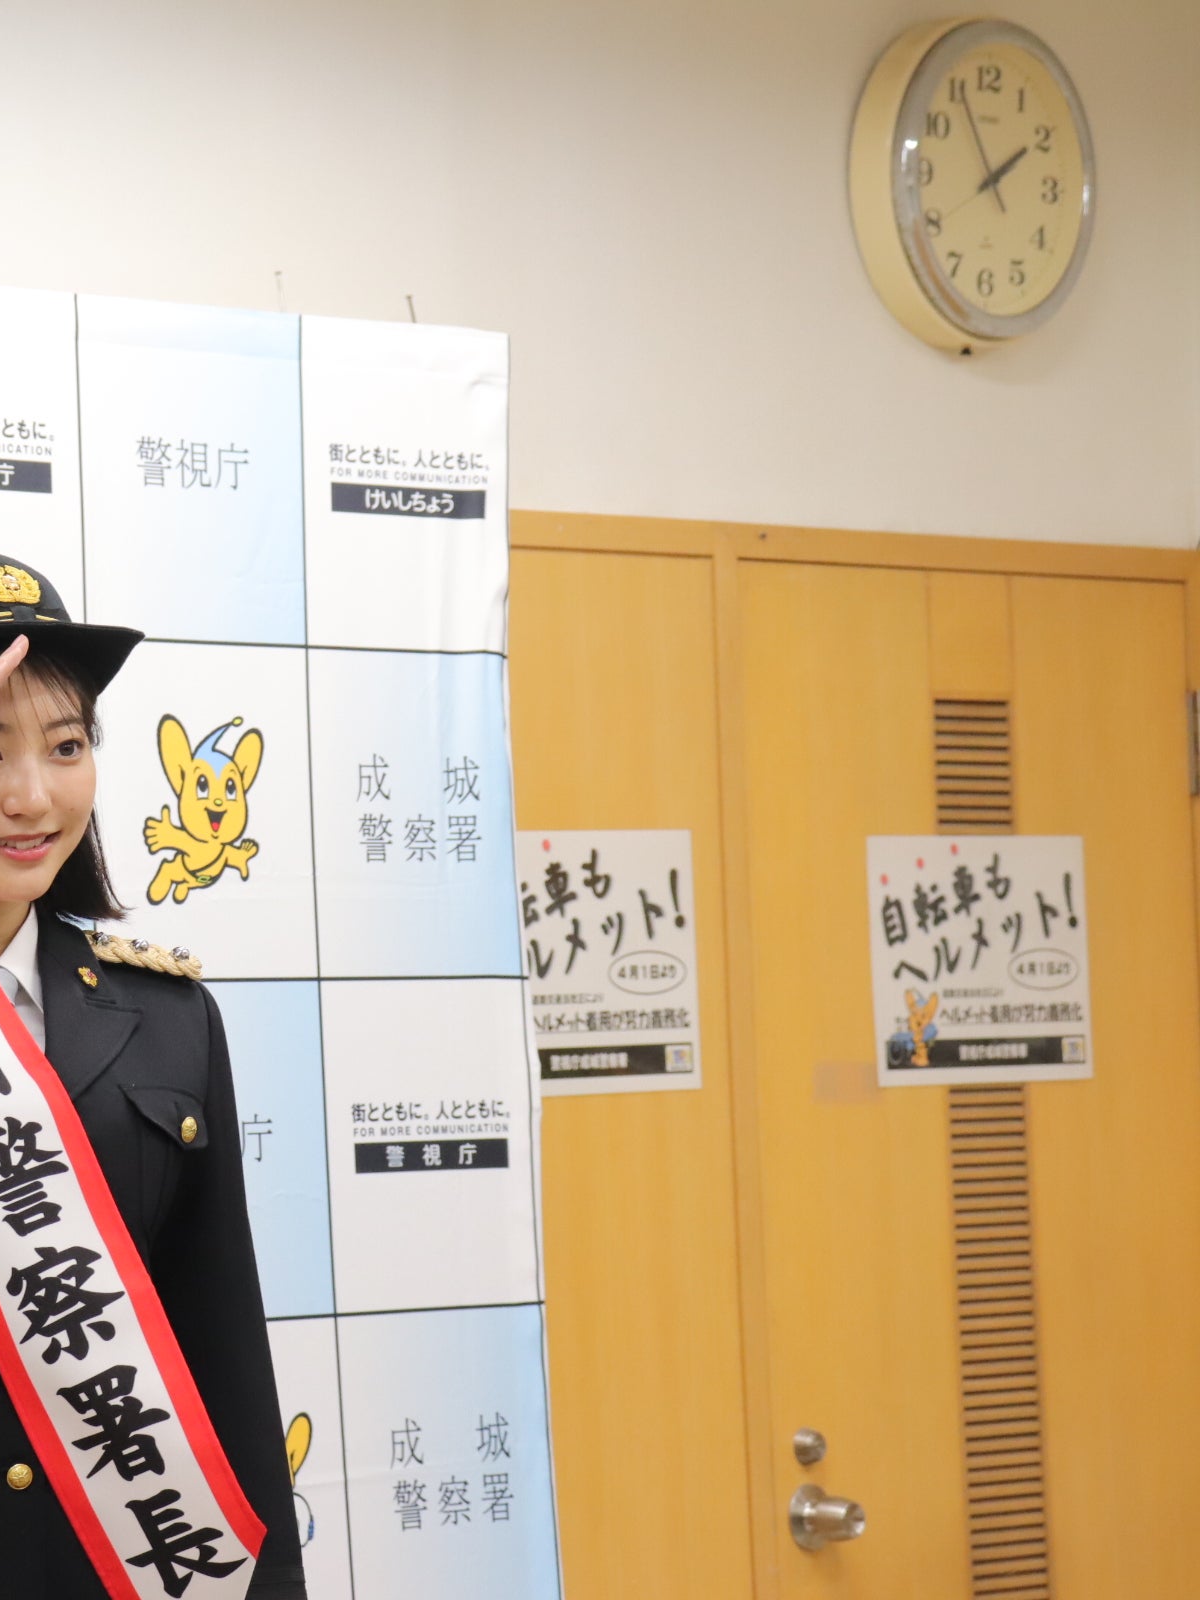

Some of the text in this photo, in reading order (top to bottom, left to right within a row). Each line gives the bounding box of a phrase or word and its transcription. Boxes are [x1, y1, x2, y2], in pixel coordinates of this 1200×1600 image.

[977, 64, 1002, 93] 12
[1016, 87, 1025, 113] 1
[925, 111, 950, 140] 10
[1034, 124, 1051, 153] 2
[918, 159, 933, 186] 9
[1041, 176, 1058, 205] 3
[924, 208, 942, 238] 8
[1030, 225, 1045, 251] 4
[947, 251, 962, 278] 7
[1009, 259, 1025, 287] 5
[977, 268, 993, 297] 6
[136, 436, 249, 490] 警視庁
[330, 467, 488, 485] FOR MORE COMMUNICATION
[365, 488, 454, 514] けいしちょう
[358, 813, 482, 863] 警察署
[881, 852, 1011, 947] 自転車も
[893, 871, 1078, 982] ヘルメット!
[618, 964, 677, 980] 4月1日より
[241, 1113, 273, 1162] 庁
[353, 1123, 509, 1137] FOR MORE COMMUNICATION
[386, 1142, 477, 1168] 警視庁
[392, 1472, 515, 1532] 警察署
